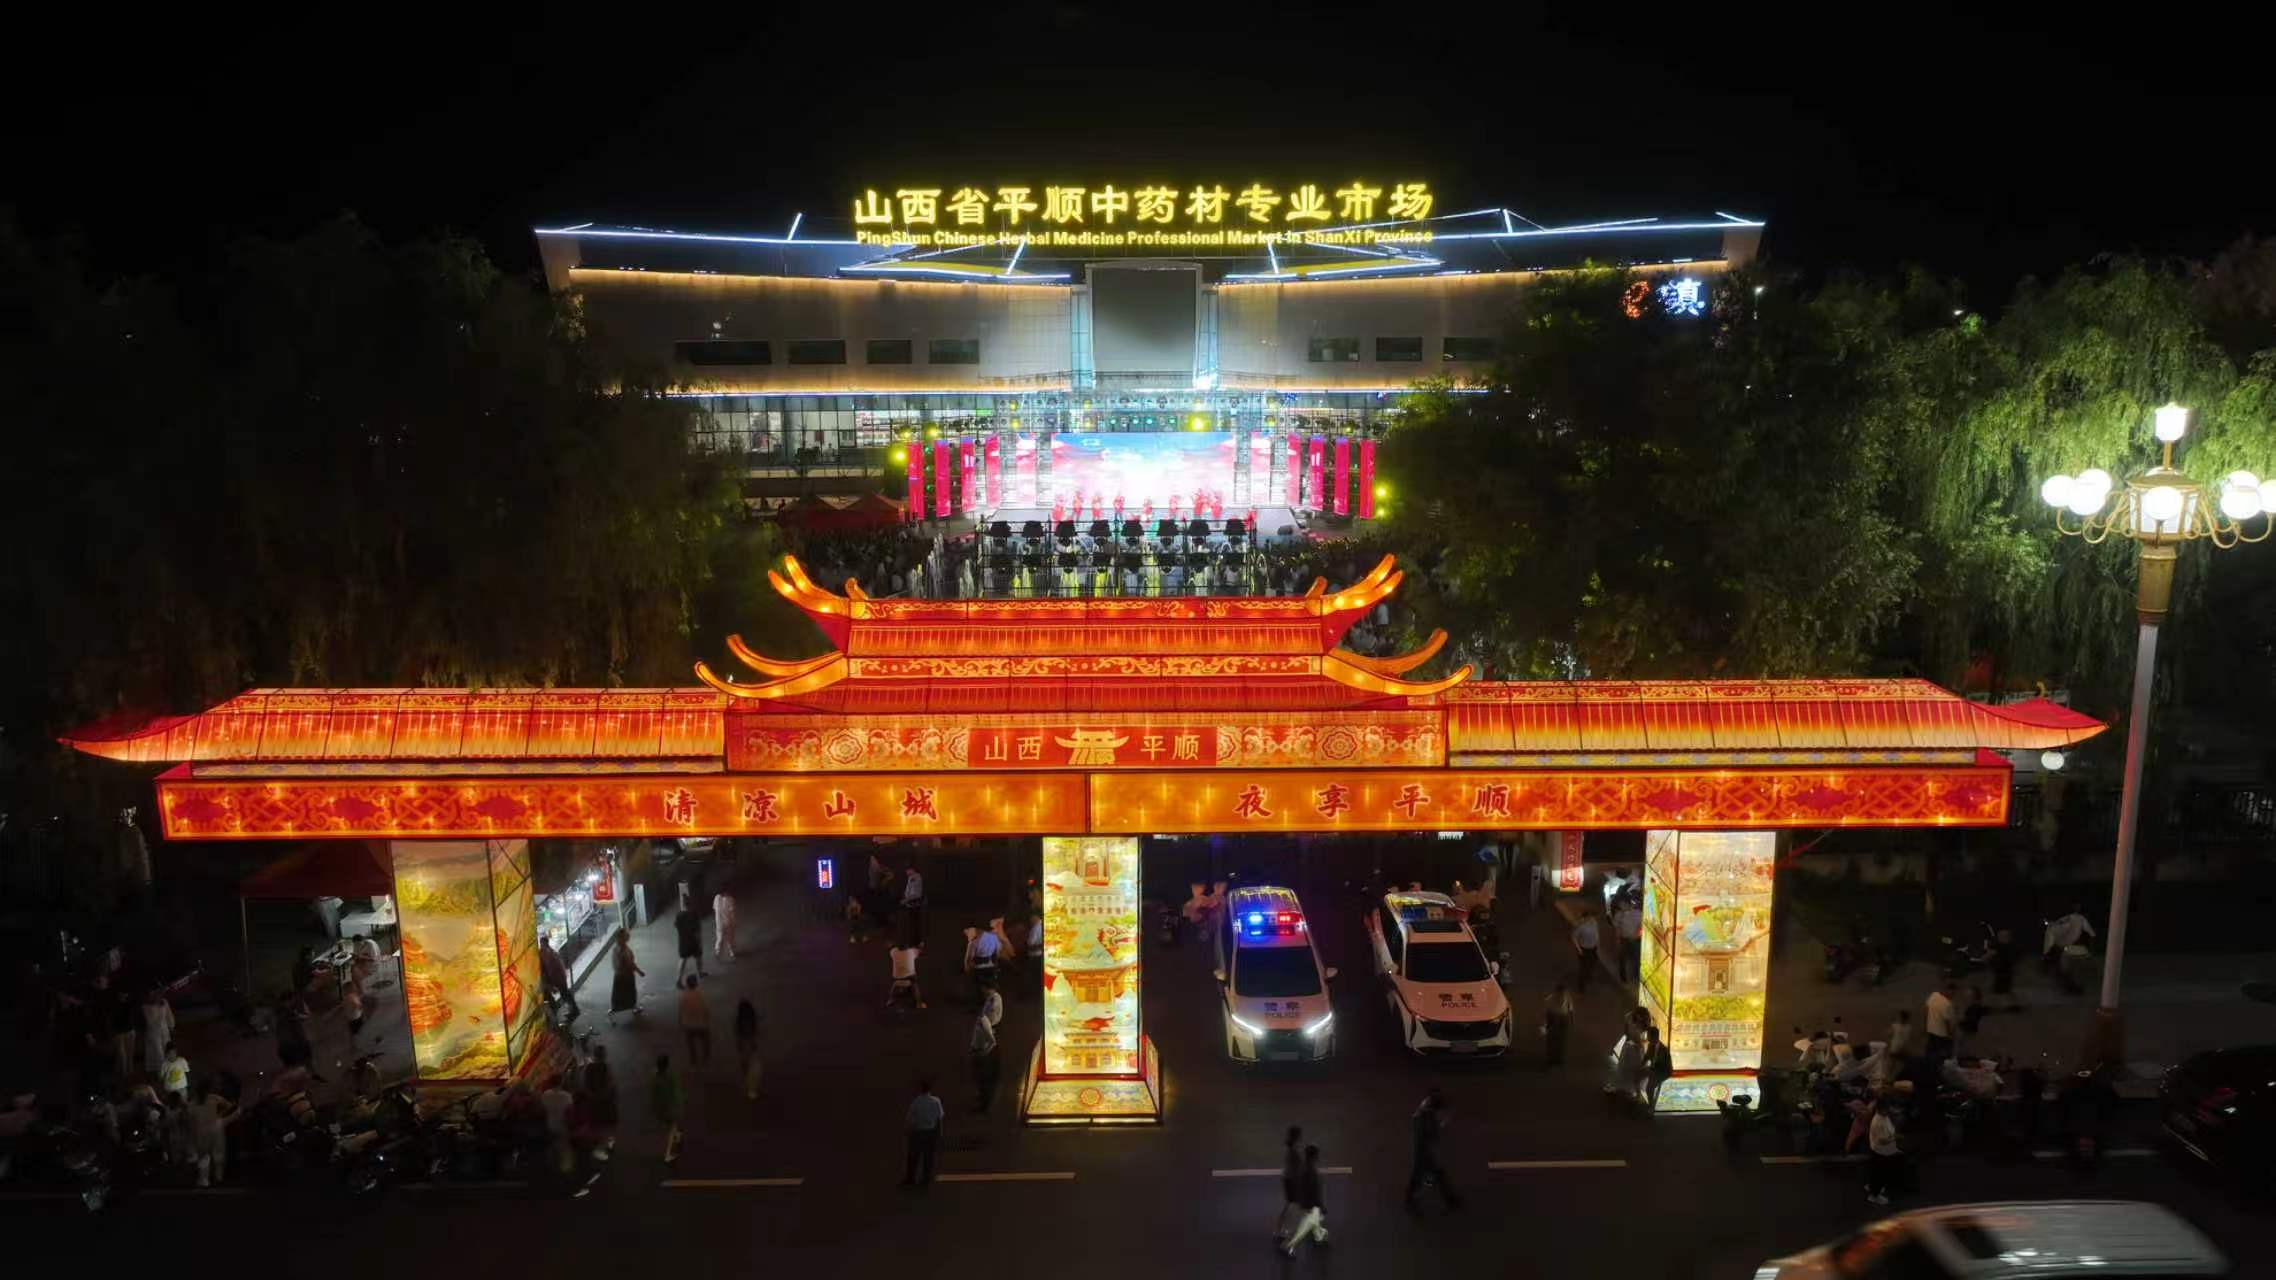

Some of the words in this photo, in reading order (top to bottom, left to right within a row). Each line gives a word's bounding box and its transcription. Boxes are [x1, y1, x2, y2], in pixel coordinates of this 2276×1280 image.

[854, 183, 1434, 224] 山西省平顺中药材专业市场
[856, 231, 932, 247] PingShun
[934, 231, 996, 246] Chinese
[999, 231, 1050, 246] Herbal
[1053, 231, 1124, 246] Medicine
[1127, 231, 1224, 246] Professional
[1227, 231, 1283, 246] Market
[1286, 230, 1301, 244] in
[1304, 230, 1361, 244] ShanXi
[1364, 229, 1434, 243] Province
[984, 736, 1042, 761] 山西
[1140, 734, 1200, 760] 平顺
[1233, 783, 1511, 819] 夜享平顺
